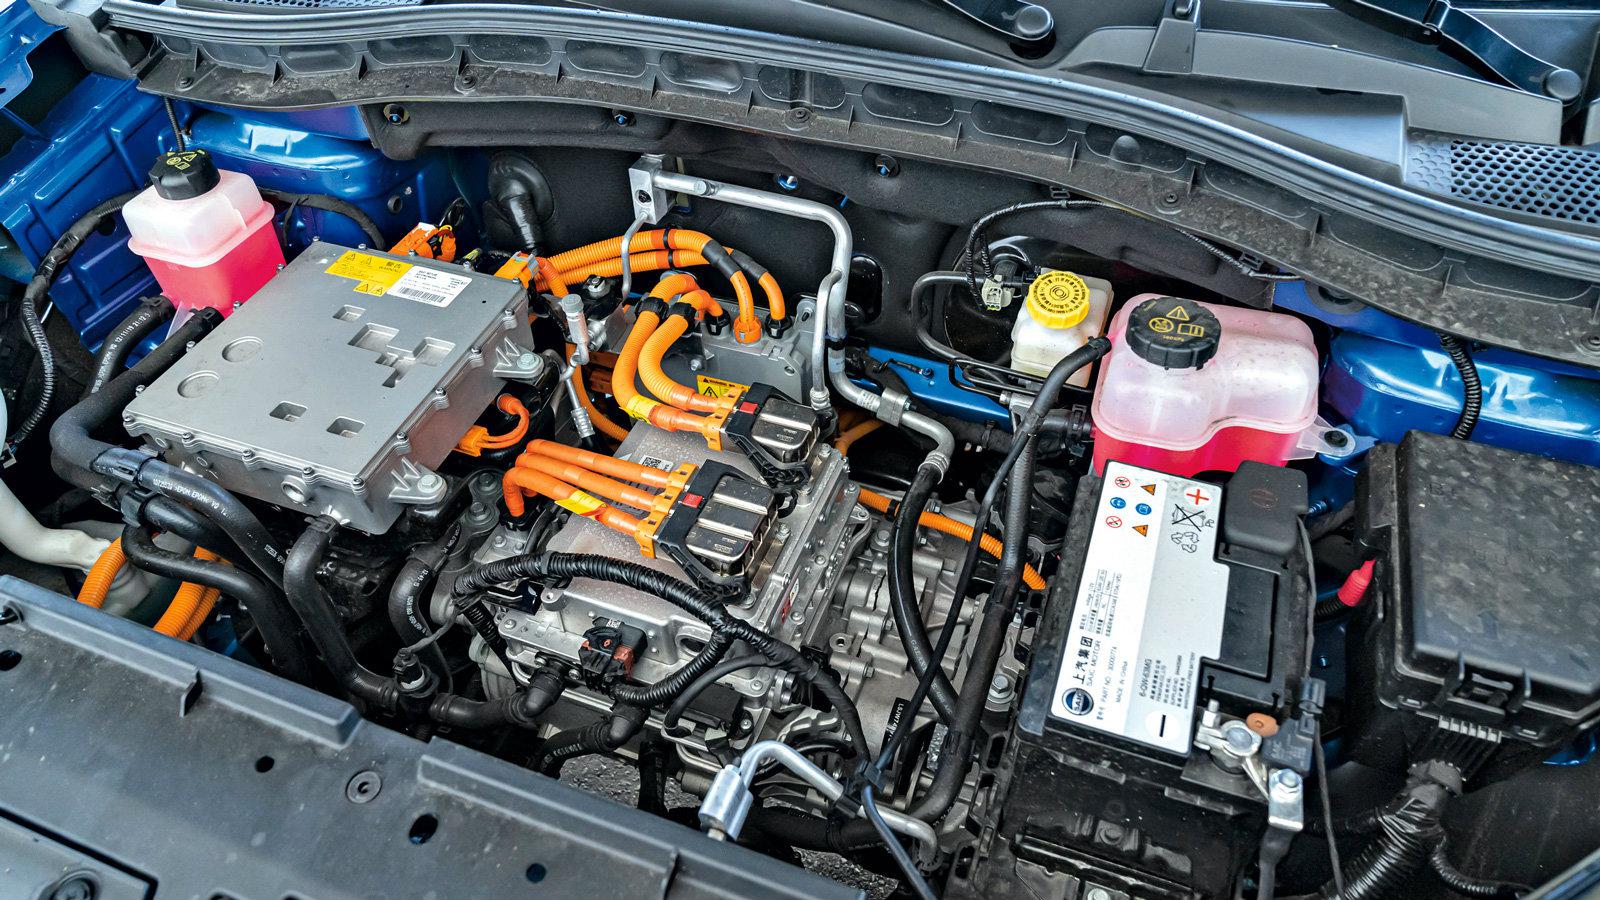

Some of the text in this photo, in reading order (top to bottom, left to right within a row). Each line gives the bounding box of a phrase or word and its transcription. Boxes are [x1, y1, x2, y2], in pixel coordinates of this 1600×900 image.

[1073, 636, 1093, 684] 上汽集团
[1085, 669, 1095, 686] SAIC
[1091, 641, 1101, 666] MOTOR
